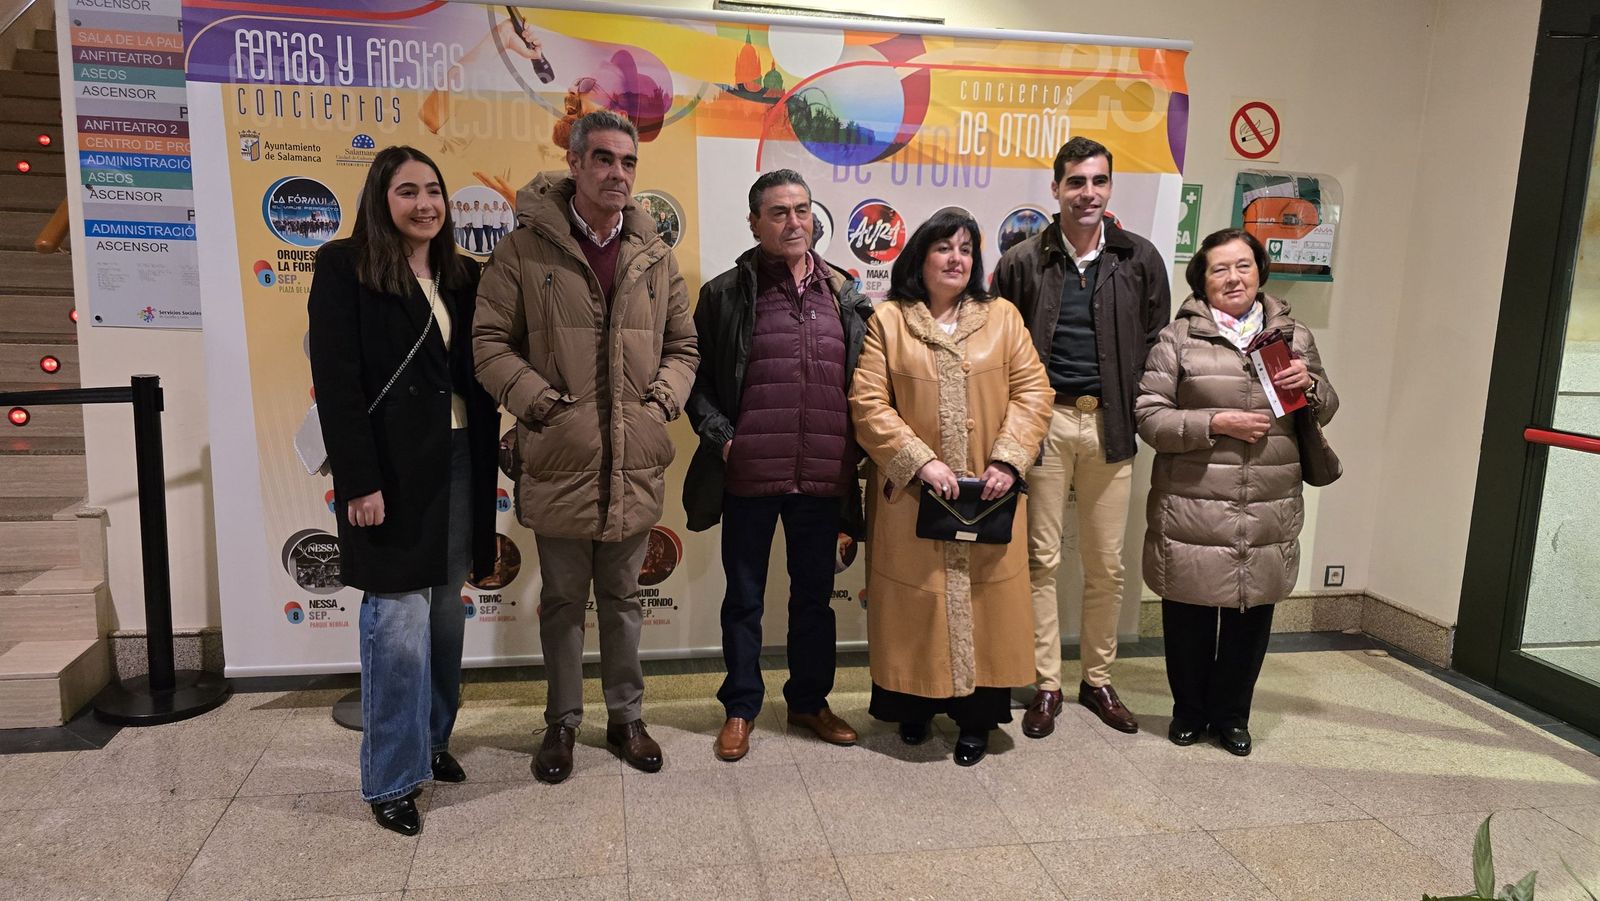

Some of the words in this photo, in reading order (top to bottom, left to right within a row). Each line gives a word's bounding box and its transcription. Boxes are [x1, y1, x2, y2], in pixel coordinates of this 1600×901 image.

[76, 0, 151, 11] ASCENSOR
[78, 32, 112, 44] SALA
[116, 35, 134, 45] DE
[138, 36, 154, 47] LA
[157, 37, 183, 48] PAL
[80, 50, 162, 65] ANFITEATRO
[165, 56, 172, 66] 1
[81, 68, 127, 80] ASEOS
[82, 86, 156, 100] ASCENSOR
[960, 80, 1073, 105] conciertos
[238, 88, 400, 123] conciertos
[84, 120, 166, 134] ANFITEATRO
[170, 125, 178, 134] 2
[998, 108, 1071, 158] OTOÑO
[86, 137, 141, 150] CENTRO
[145, 140, 162, 150] DE
[264, 141, 321, 153] Ayuntamiento
[278, 153, 322, 162] Salamanca
[88, 172, 134, 184] ASEOS
[90, 189, 163, 202] ASCENSOR
[92, 224, 194, 238] ADMINISTRACIÓ
[96, 241, 168, 252] ASCENSOR
[277, 250, 318, 261] ORQUES
[278, 262, 290, 272] LA
[264, 274, 270, 284] 6
[278, 274, 300, 284] SEP.
[866, 270, 888, 278] MAKA
[866, 281, 884, 290] SEP.
[498, 500, 508, 508] 14
[308, 543, 340, 552] NESSA
[309, 600, 338, 608] NESSA
[478, 594, 502, 604] TBMC
[648, 598, 673, 606] FONDO
[464, 606, 474, 615] 10
[480, 606, 500, 614] SEP.
[642, 610, 654, 618] EP.
[293, 611, 299, 620] 8
[309, 611, 330, 620] SEP.
